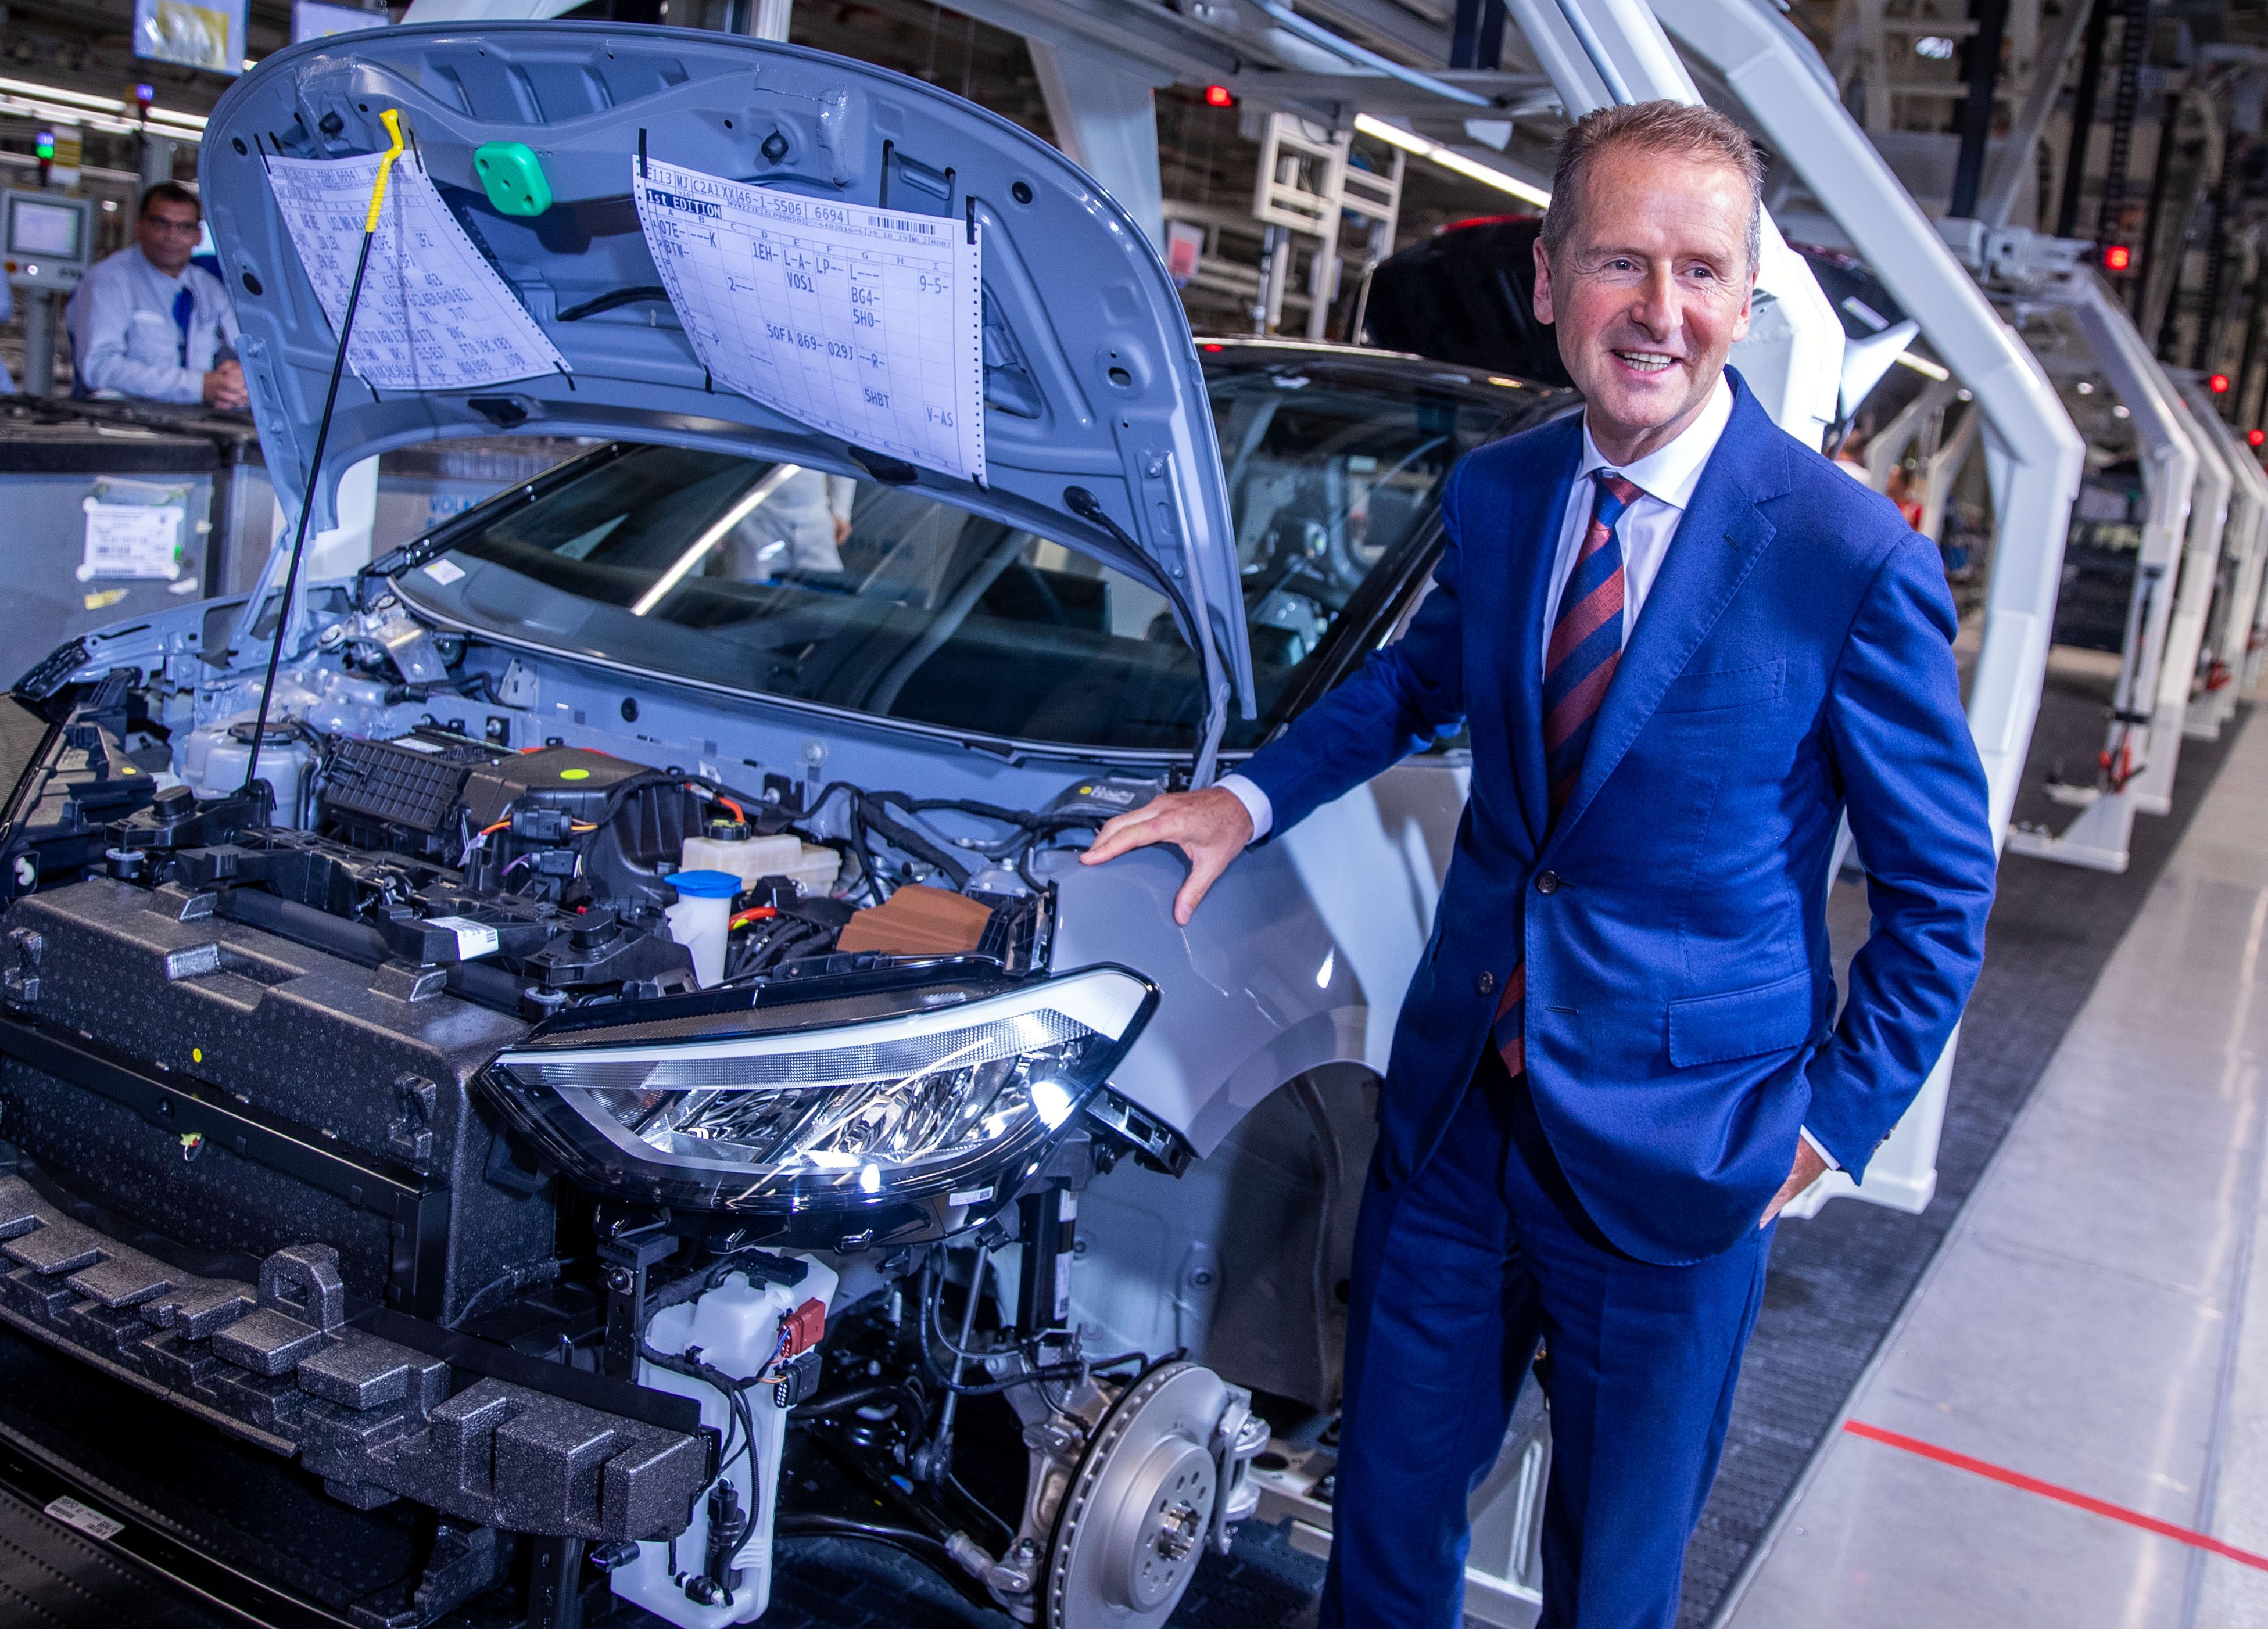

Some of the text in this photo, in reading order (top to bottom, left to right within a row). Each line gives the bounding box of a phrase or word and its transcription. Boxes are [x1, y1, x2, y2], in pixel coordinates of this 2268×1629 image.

[647, 189, 722, 220] 1st EDITION
[676, 174, 689, 189] MJ
[693, 180, 736, 203] C2A1XX
[739, 191, 802, 216] 46-1-5506
[815, 206, 844, 223] 6694
[753, 242, 949, 294] 1EH- L-A- LP-- L--- 9-5-
[793, 238, 800, 246] E
[897, 256, 904, 264] H
[933, 262, 940, 270] I
[851, 286, 880, 306] BG4-
[797, 332, 823, 350] 869-
[827, 341, 854, 360] 029J
[864, 387, 890, 408] 5HBT
[926, 406, 954, 428] V-AS
